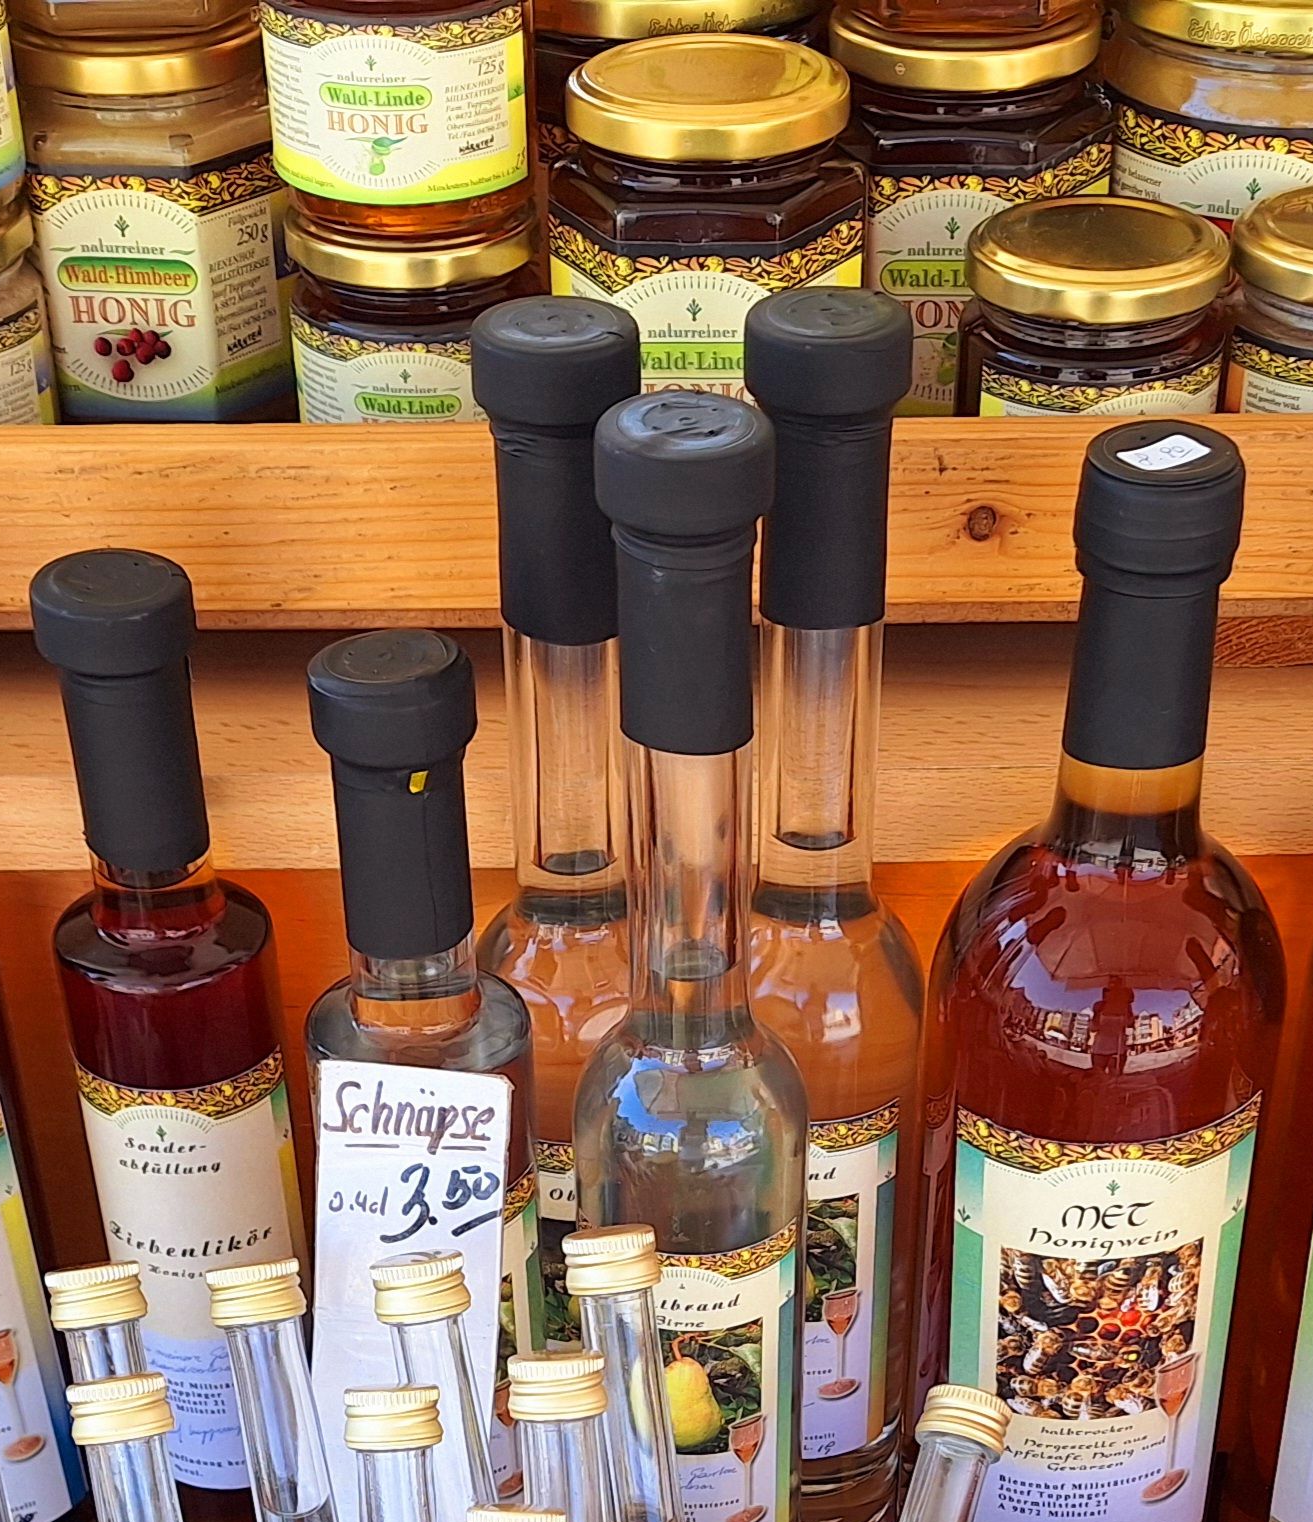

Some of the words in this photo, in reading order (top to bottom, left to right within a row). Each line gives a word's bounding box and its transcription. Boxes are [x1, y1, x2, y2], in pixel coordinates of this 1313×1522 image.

[337, 70, 407, 84] naturreiner
[477, 60, 496, 76] 125
[327, 87, 424, 107] Wald-Linde
[327, 110, 428, 135] HONIG
[237, 225, 258, 247] 250
[258, 222, 269, 244] g
[81, 238, 165, 256] naturreiner
[64, 263, 191, 287] Wald-Himbeer
[68, 295, 197, 328] HONIG
[647, 322, 738, 339] naturreiner
[372, 383, 438, 394] naturreiner
[361, 396, 455, 415] Wald-Linde
[323, 1080, 496, 1155] Schnäpse
[123, 1136, 207, 1155] Sonder-
[118, 1157, 223, 1177] abfüllung
[379, 1162, 500, 1244] 3.50
[1060, 1200, 1155, 1231] MET
[107, 1220, 274, 1259] Zirbenlikör
[1027, 1226, 1180, 1257] Honigwein
[999, 1474, 1066, 1491] Bienenhof
[1071, 1468, 1162, 1491] Millstättersee
[998, 1484, 1032, 1497] Josef
[998, 1493, 1090, 1509] Obermillstatt
[1012, 1505, 1041, 1517] 9872
[1048, 1509, 1108, 1518] Millstatt
